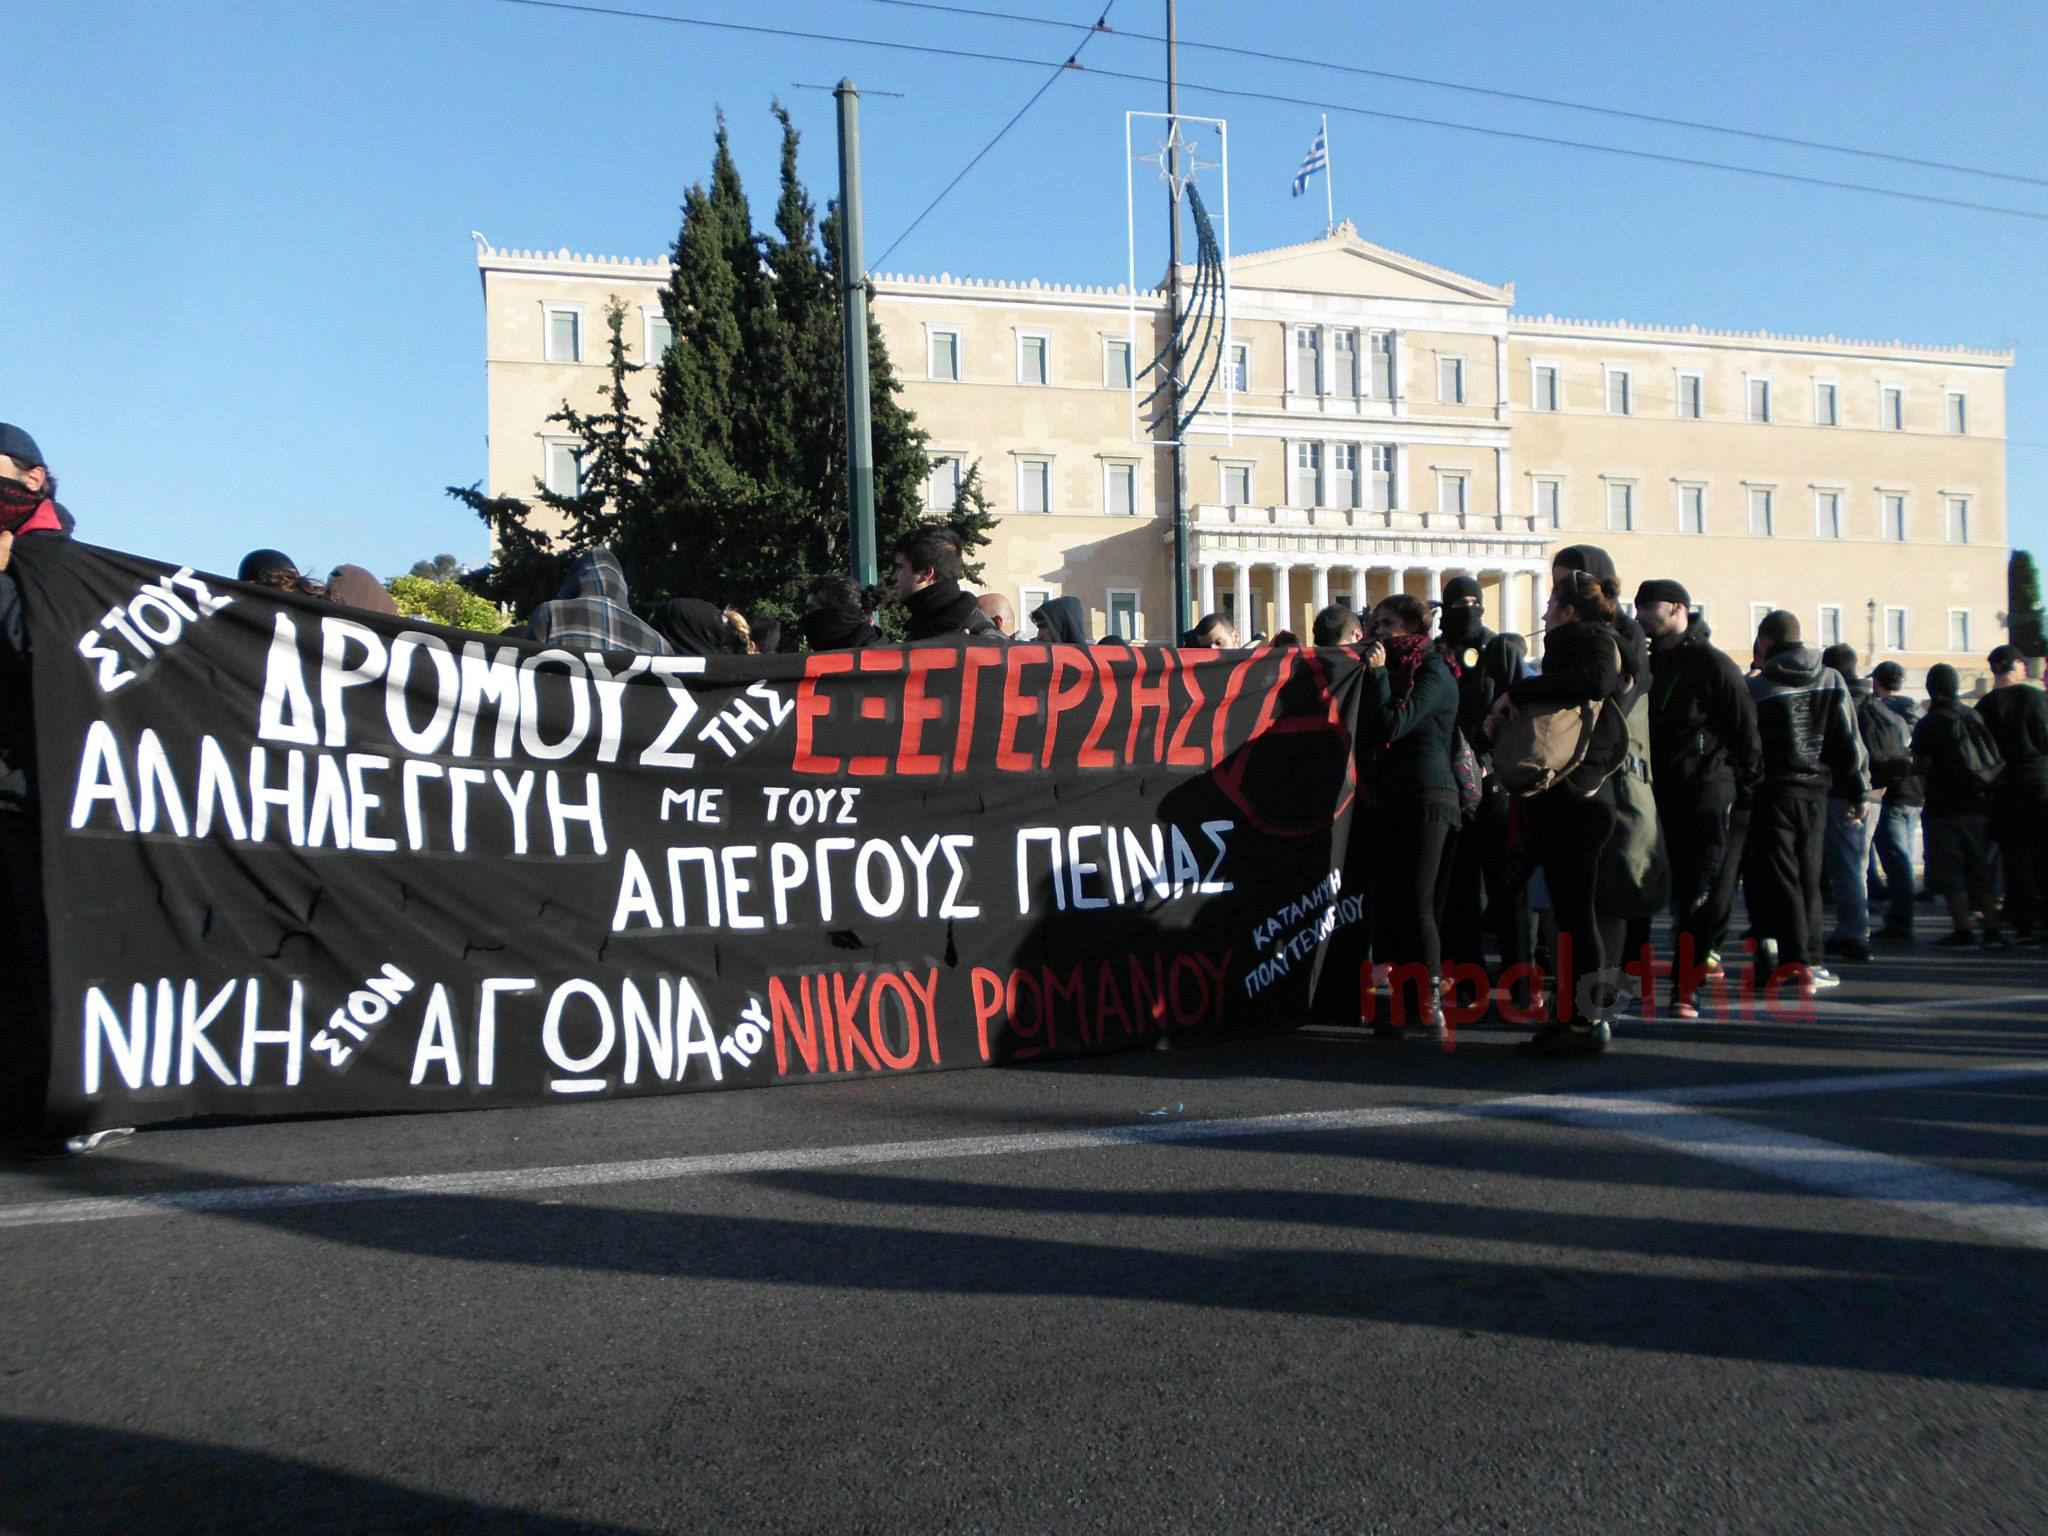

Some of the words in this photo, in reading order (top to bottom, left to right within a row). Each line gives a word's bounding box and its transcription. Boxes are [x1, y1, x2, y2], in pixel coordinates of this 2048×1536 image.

[78, 566, 234, 693] ΣΤΟΥΣ
[258, 612, 705, 768] ΔΡΟΜΟΥΣ
[698, 680, 795, 760] ΤΗΣ
[792, 645, 1221, 774] ΕΞΕΓΕΡΣΗΣ
[71, 720, 607, 855] ΑΛΛΗΛΕΓΓΥΗ
[661, 788, 723, 823] ΜΕ
[763, 787, 860, 825] ΤΟΥΣ
[612, 834, 980, 932] ΑΠΕΡΓΟΥΣ
[1016, 820, 1234, 915] ΠΕΙΝΑΣ
[85, 978, 302, 1093] ΝΙΚΗ
[310, 963, 415, 1066] ΣΤΟΝ
[720, 997, 771, 1068] ΤΟΥ
[769, 967, 940, 1076] ΝΙΚΟΥ
